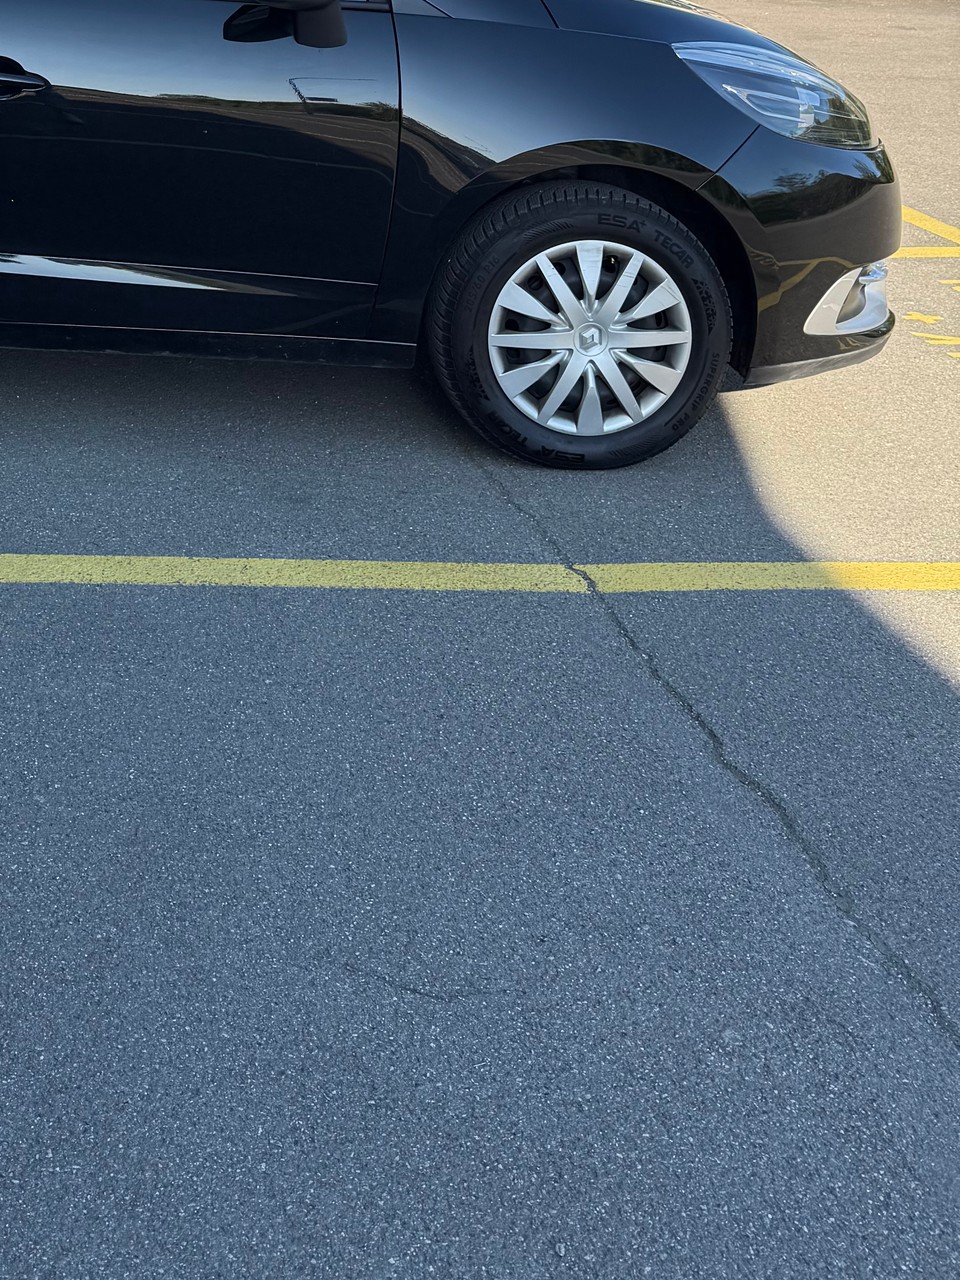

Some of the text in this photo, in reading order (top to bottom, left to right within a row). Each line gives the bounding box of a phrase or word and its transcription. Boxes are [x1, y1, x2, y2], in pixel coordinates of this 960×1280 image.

[653, 229, 695, 269] TECAR
[671, 351, 720, 431] SUPERGRIP PRO
